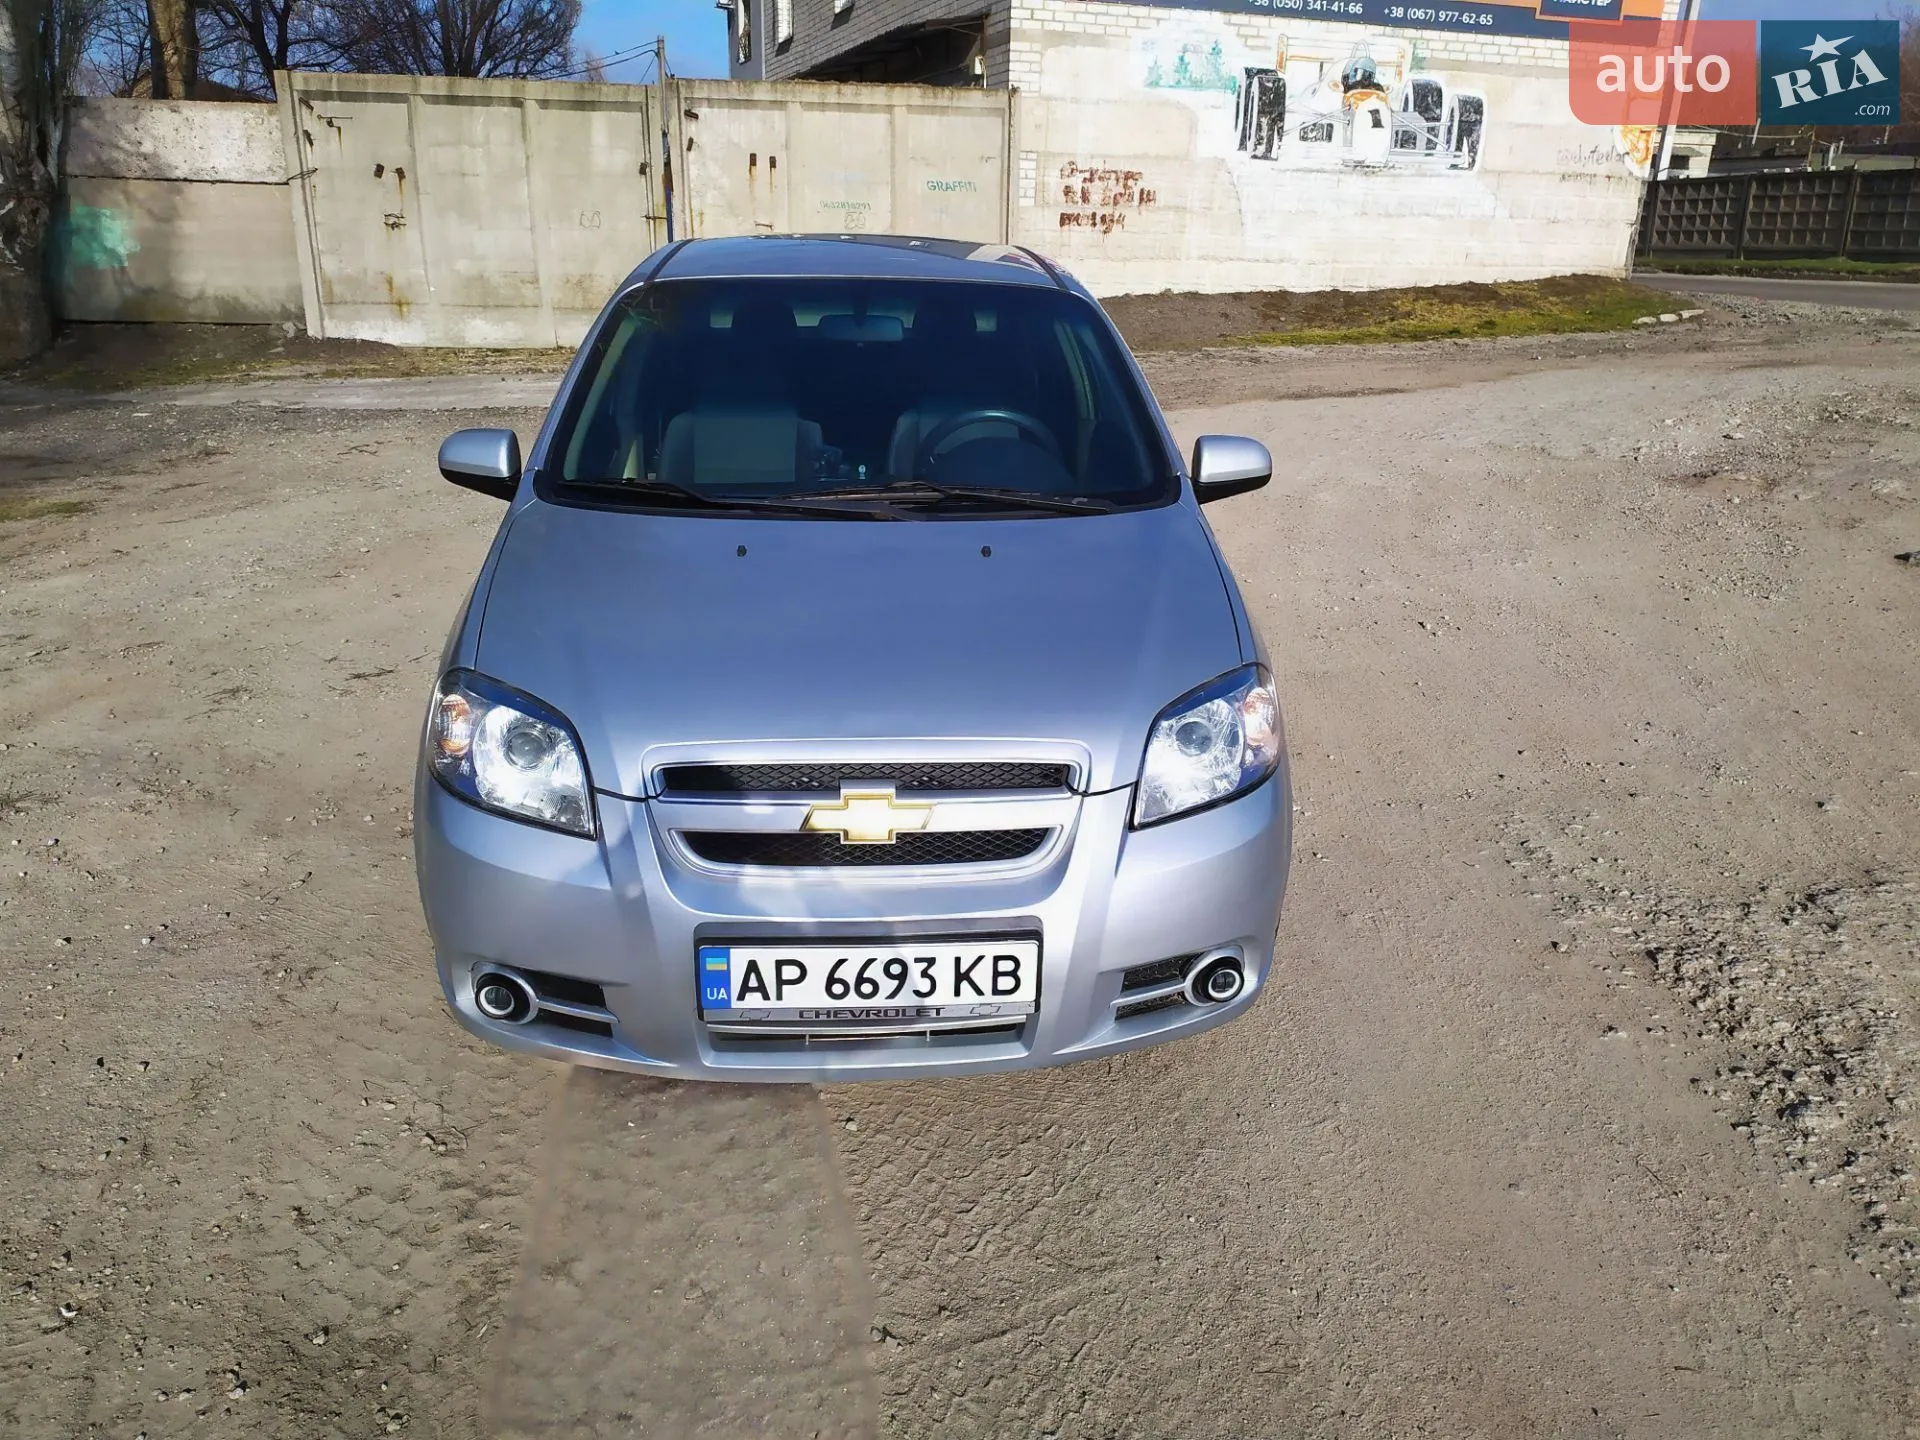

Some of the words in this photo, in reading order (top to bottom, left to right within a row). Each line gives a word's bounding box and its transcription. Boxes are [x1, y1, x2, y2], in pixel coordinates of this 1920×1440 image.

[1273, 0, 1303, 10] (050)
[1306, 0, 1363, 14] 341-41-66
[1383, 6, 1404, 18] +38
[1407, 7, 1435, 22] (067)
[1438, 10, 1493, 25] 977-62-65
[1368, 108, 1385, 129] 1
[926, 180, 977, 192] GRAFFITI
[736, 958, 808, 1002] AP
[825, 956, 938, 1000] 6693
[953, 954, 1022, 998] KB
[706, 987, 728, 1001] UA
[799, 1006, 945, 1021] CHEVROLET
